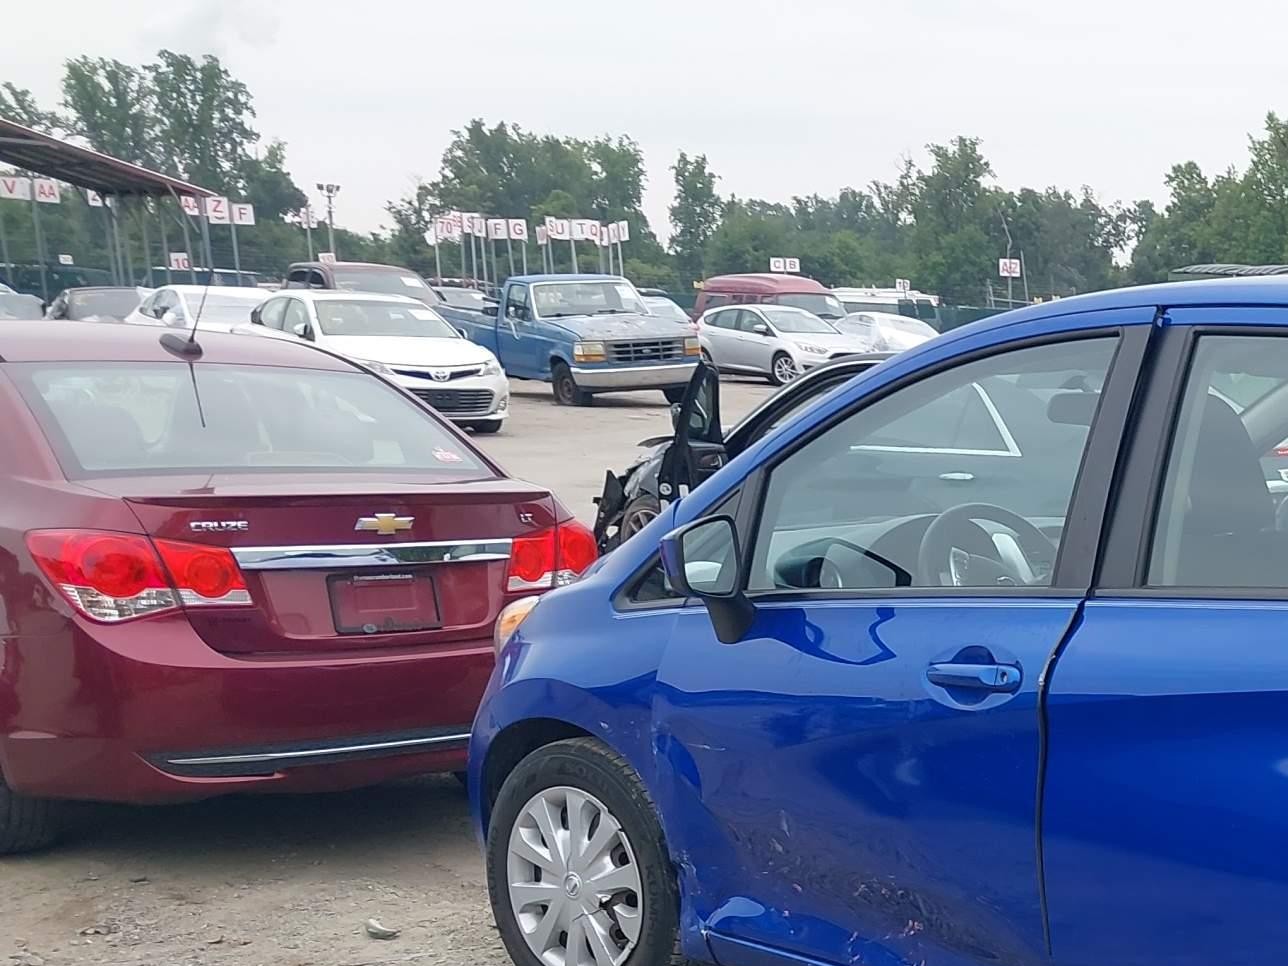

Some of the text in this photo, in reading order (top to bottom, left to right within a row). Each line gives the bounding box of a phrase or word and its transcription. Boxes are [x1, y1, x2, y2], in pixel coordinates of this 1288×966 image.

[2, 178, 16, 194] V
[38, 183, 57, 198] AA
[212, 199, 224, 214] Z
[239, 207, 248, 221] F
[494, 223, 502, 235] F
[513, 223, 524, 235] G
[577, 223, 586, 234] T
[789, 260, 797, 270] B
[519, 513, 534, 523] LT
[189, 520, 249, 532] CRUZE
